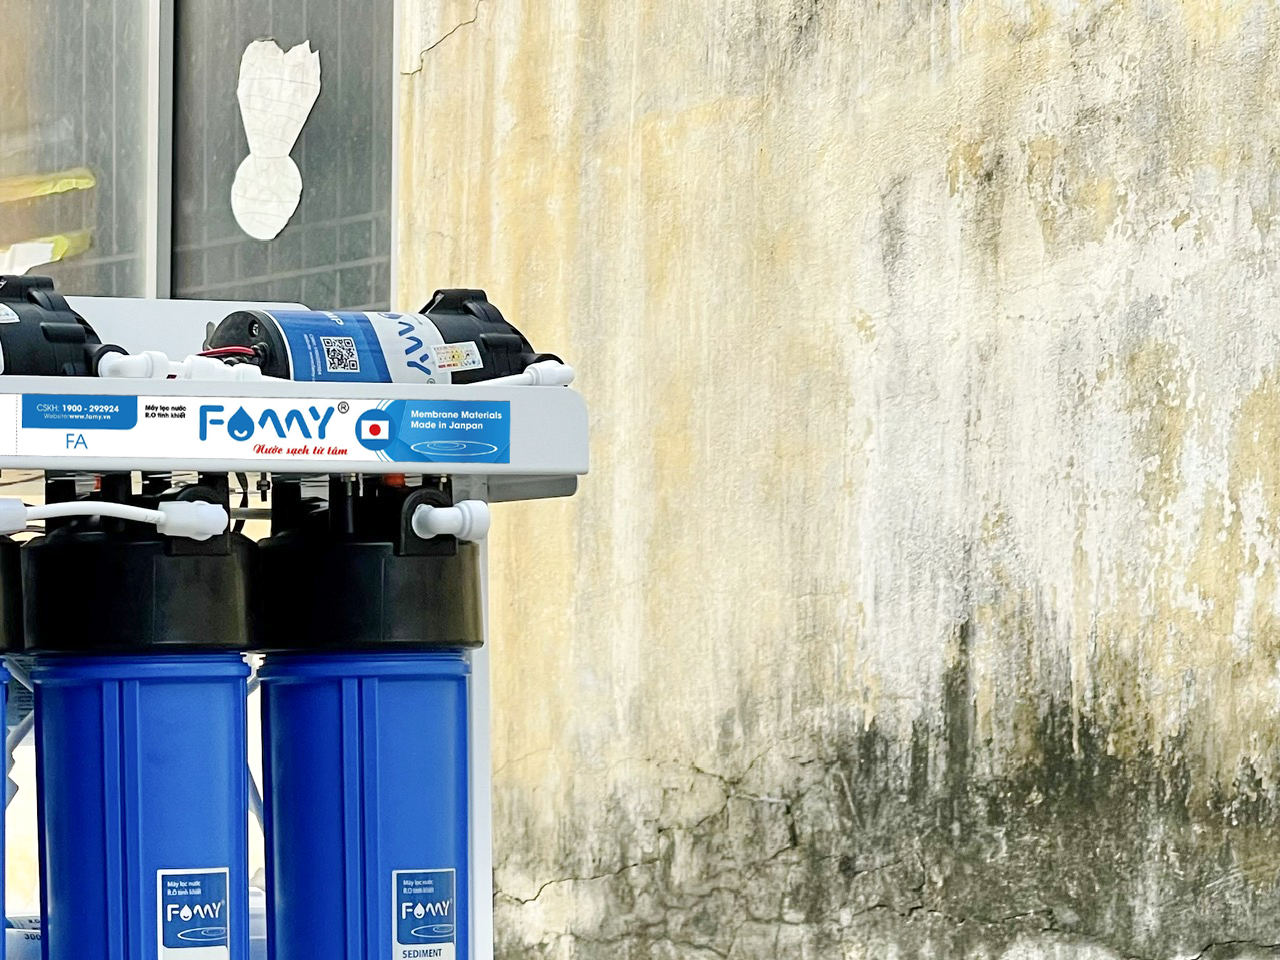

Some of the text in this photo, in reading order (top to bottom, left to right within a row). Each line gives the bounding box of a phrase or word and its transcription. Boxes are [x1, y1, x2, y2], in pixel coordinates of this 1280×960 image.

[36, 403, 60, 412] CSKH:
[62, 404, 82, 412] 1900
[89, 404, 120, 413] 292924
[411, 410, 502, 419] Membrane Materials
[411, 421, 483, 431] Made in Janpan
[66, 433, 89, 449] FA
[253, 444, 349, 456] Nước sạch từ tâm
[402, 948, 442, 958] SEDIMENT
